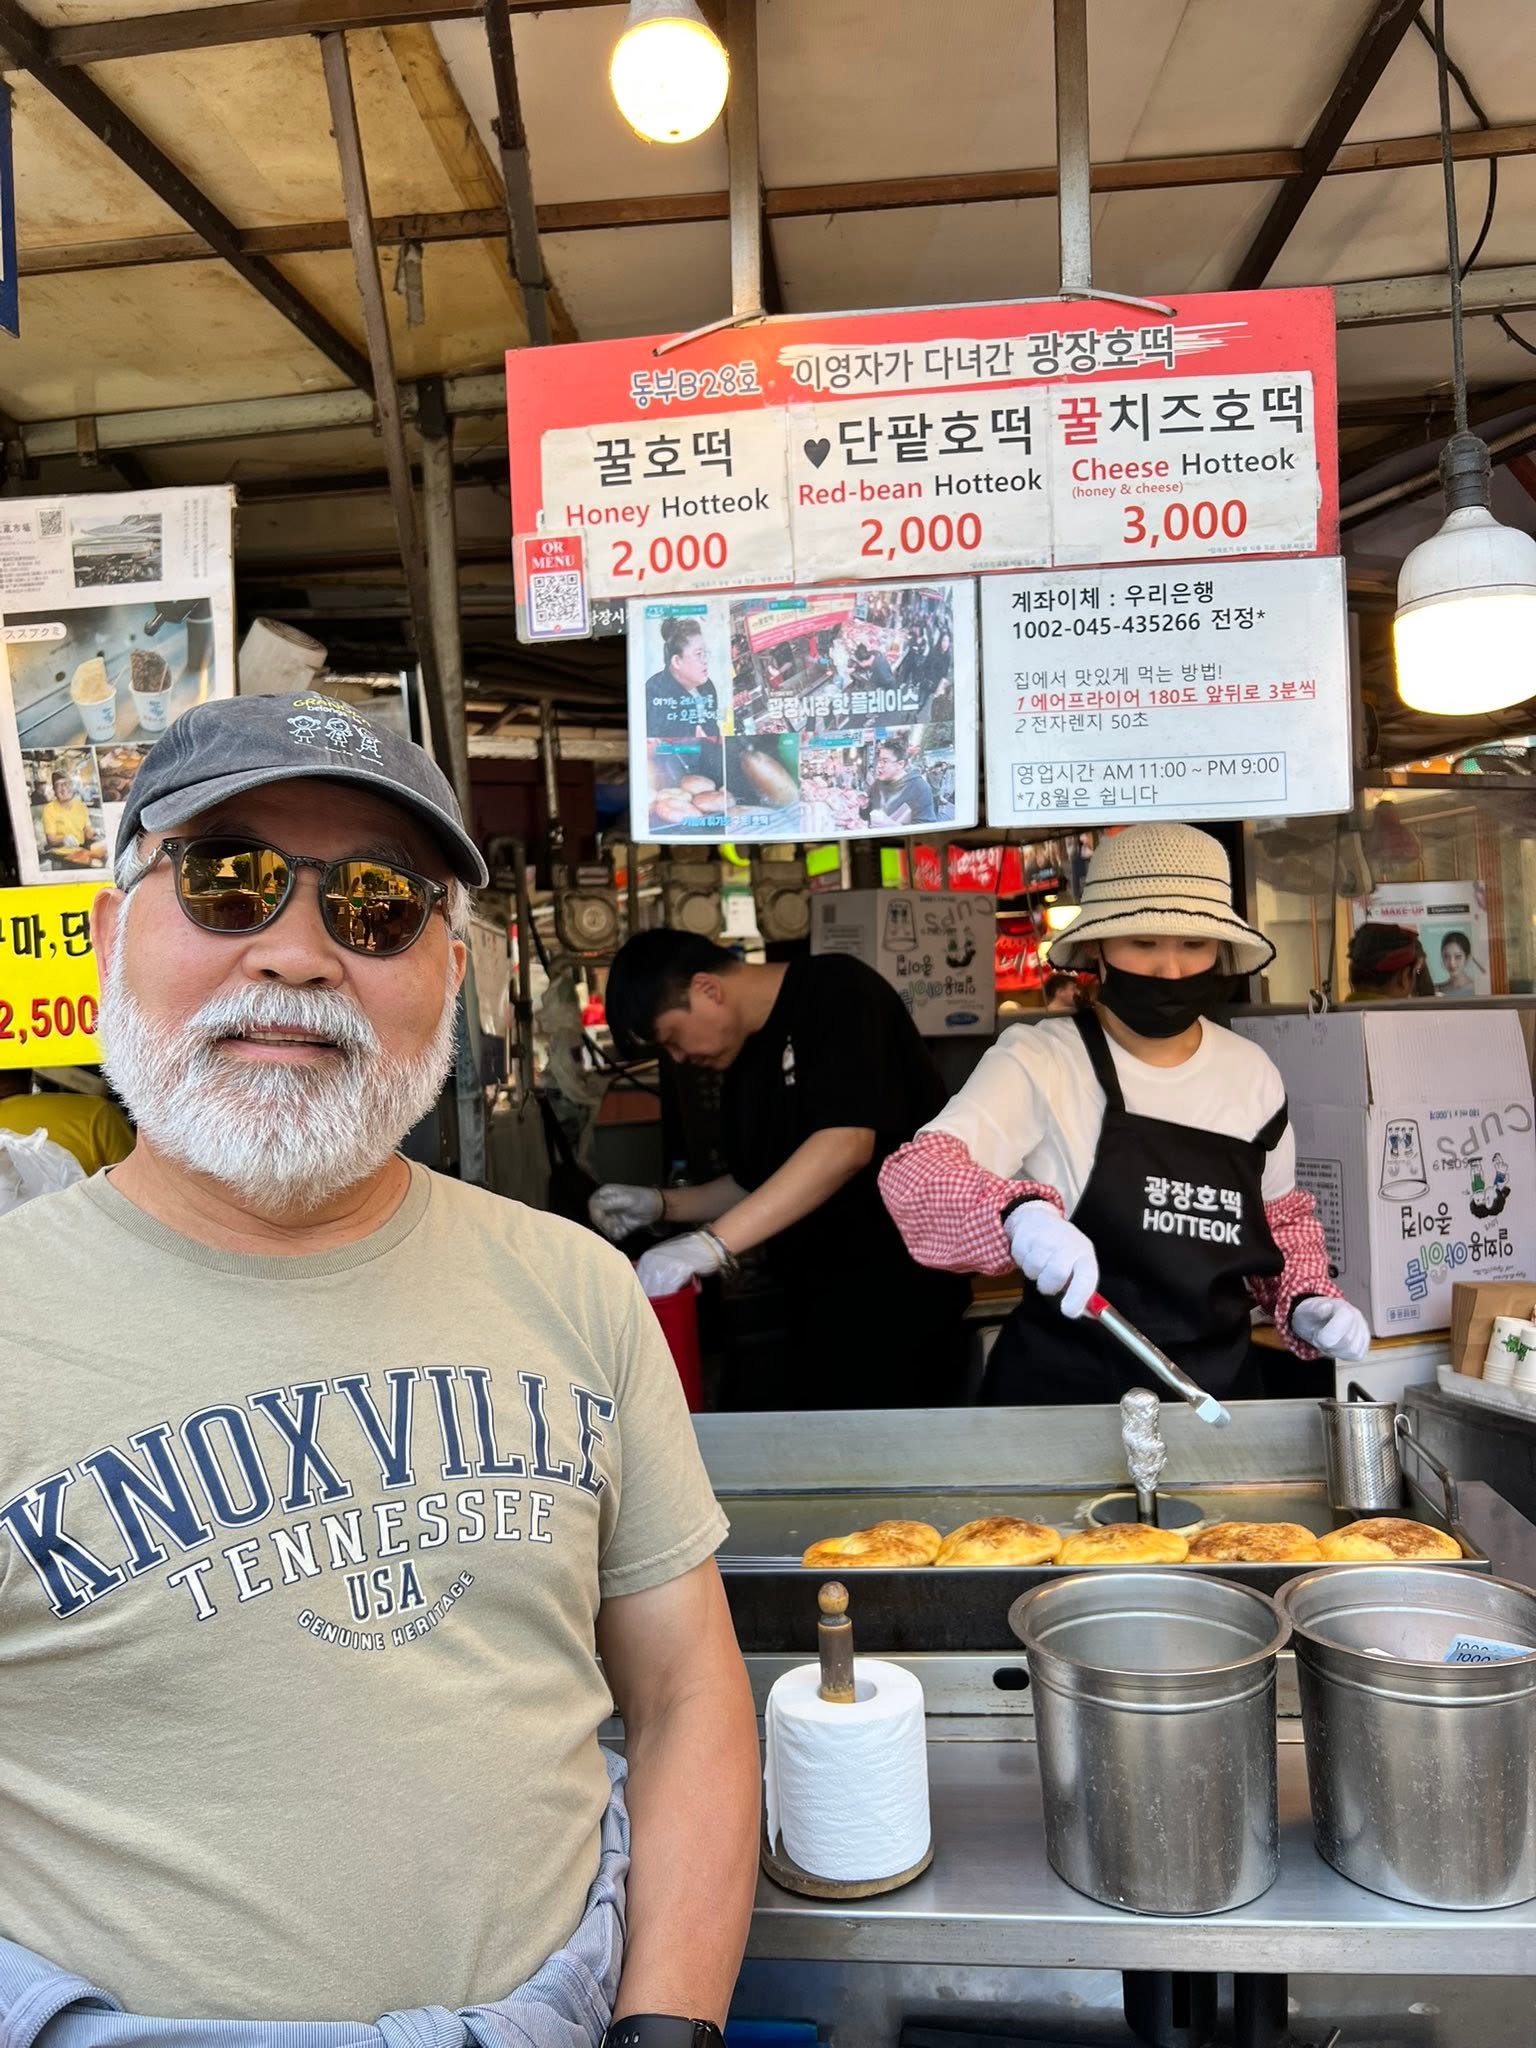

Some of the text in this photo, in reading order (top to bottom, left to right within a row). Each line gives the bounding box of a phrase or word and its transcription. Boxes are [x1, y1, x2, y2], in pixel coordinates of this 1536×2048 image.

[796, 325, 1175, 391] 이영자가 다녀간 광장호떡
[631, 361, 762, 408] 동부B28호
[1057, 384, 1303, 446] 꿀치즈호떡
[839, 406, 1032, 466] 단팥호떡
[594, 428, 734, 487] 꿀호떡
[1072, 448, 1295, 481] Cheese Hotteok
[799, 469, 1042, 506] Red-bean Hotteok
[1071, 481, 1184, 499] (honey & cheese)
[566, 489, 769, 528] Honey Hotteok
[1122, 499, 1247, 549] 3,000
[541, 541, 565, 556] QR
[861, 512, 982, 561] 2,000
[532, 554, 575, 569] MENU
[611, 532, 729, 581] 2,000
[1012, 586, 1101, 613] 계좌이체
[1124, 580, 1215, 607] 우리은행
[1013, 612, 1201, 640] 1002-045-435266
[1014, 662, 1222, 691] 집에서 맛있게 먹는 방법!
[1016, 679, 1317, 712] 1 에어프라이어 180도 앞뒤로 3분씩
[768, 694, 831, 719] 광장시장
[1015, 711, 1149, 734] 2 전자렌지 50초
[1016, 763, 1095, 786] 영업시간
[1102, 762, 1134, 780] AM
[1139, 760, 1187, 779] 11:00
[1207, 759, 1237, 776] PM
[1241, 756, 1280, 775] 9:00
[1100, 784, 1159, 807] 쉽니다
[0, 995, 98, 1045] 2,500
[1437, 1103, 1532, 1159] CUPS
[1144, 1176, 1243, 1220] 광장호떡
[1143, 1208, 1241, 1246] HOTTEOK
[1401, 1202, 1453, 1240] 종이컵
[1468, 1228, 1514, 1262] 일회용
[0, 1365, 615, 1620] KNOXVILLE
[168, 1490, 556, 1621] TENNESSEE
[345, 1558, 426, 1624] USA
[298, 1570, 475, 1651] GENUINE HERITAGE
